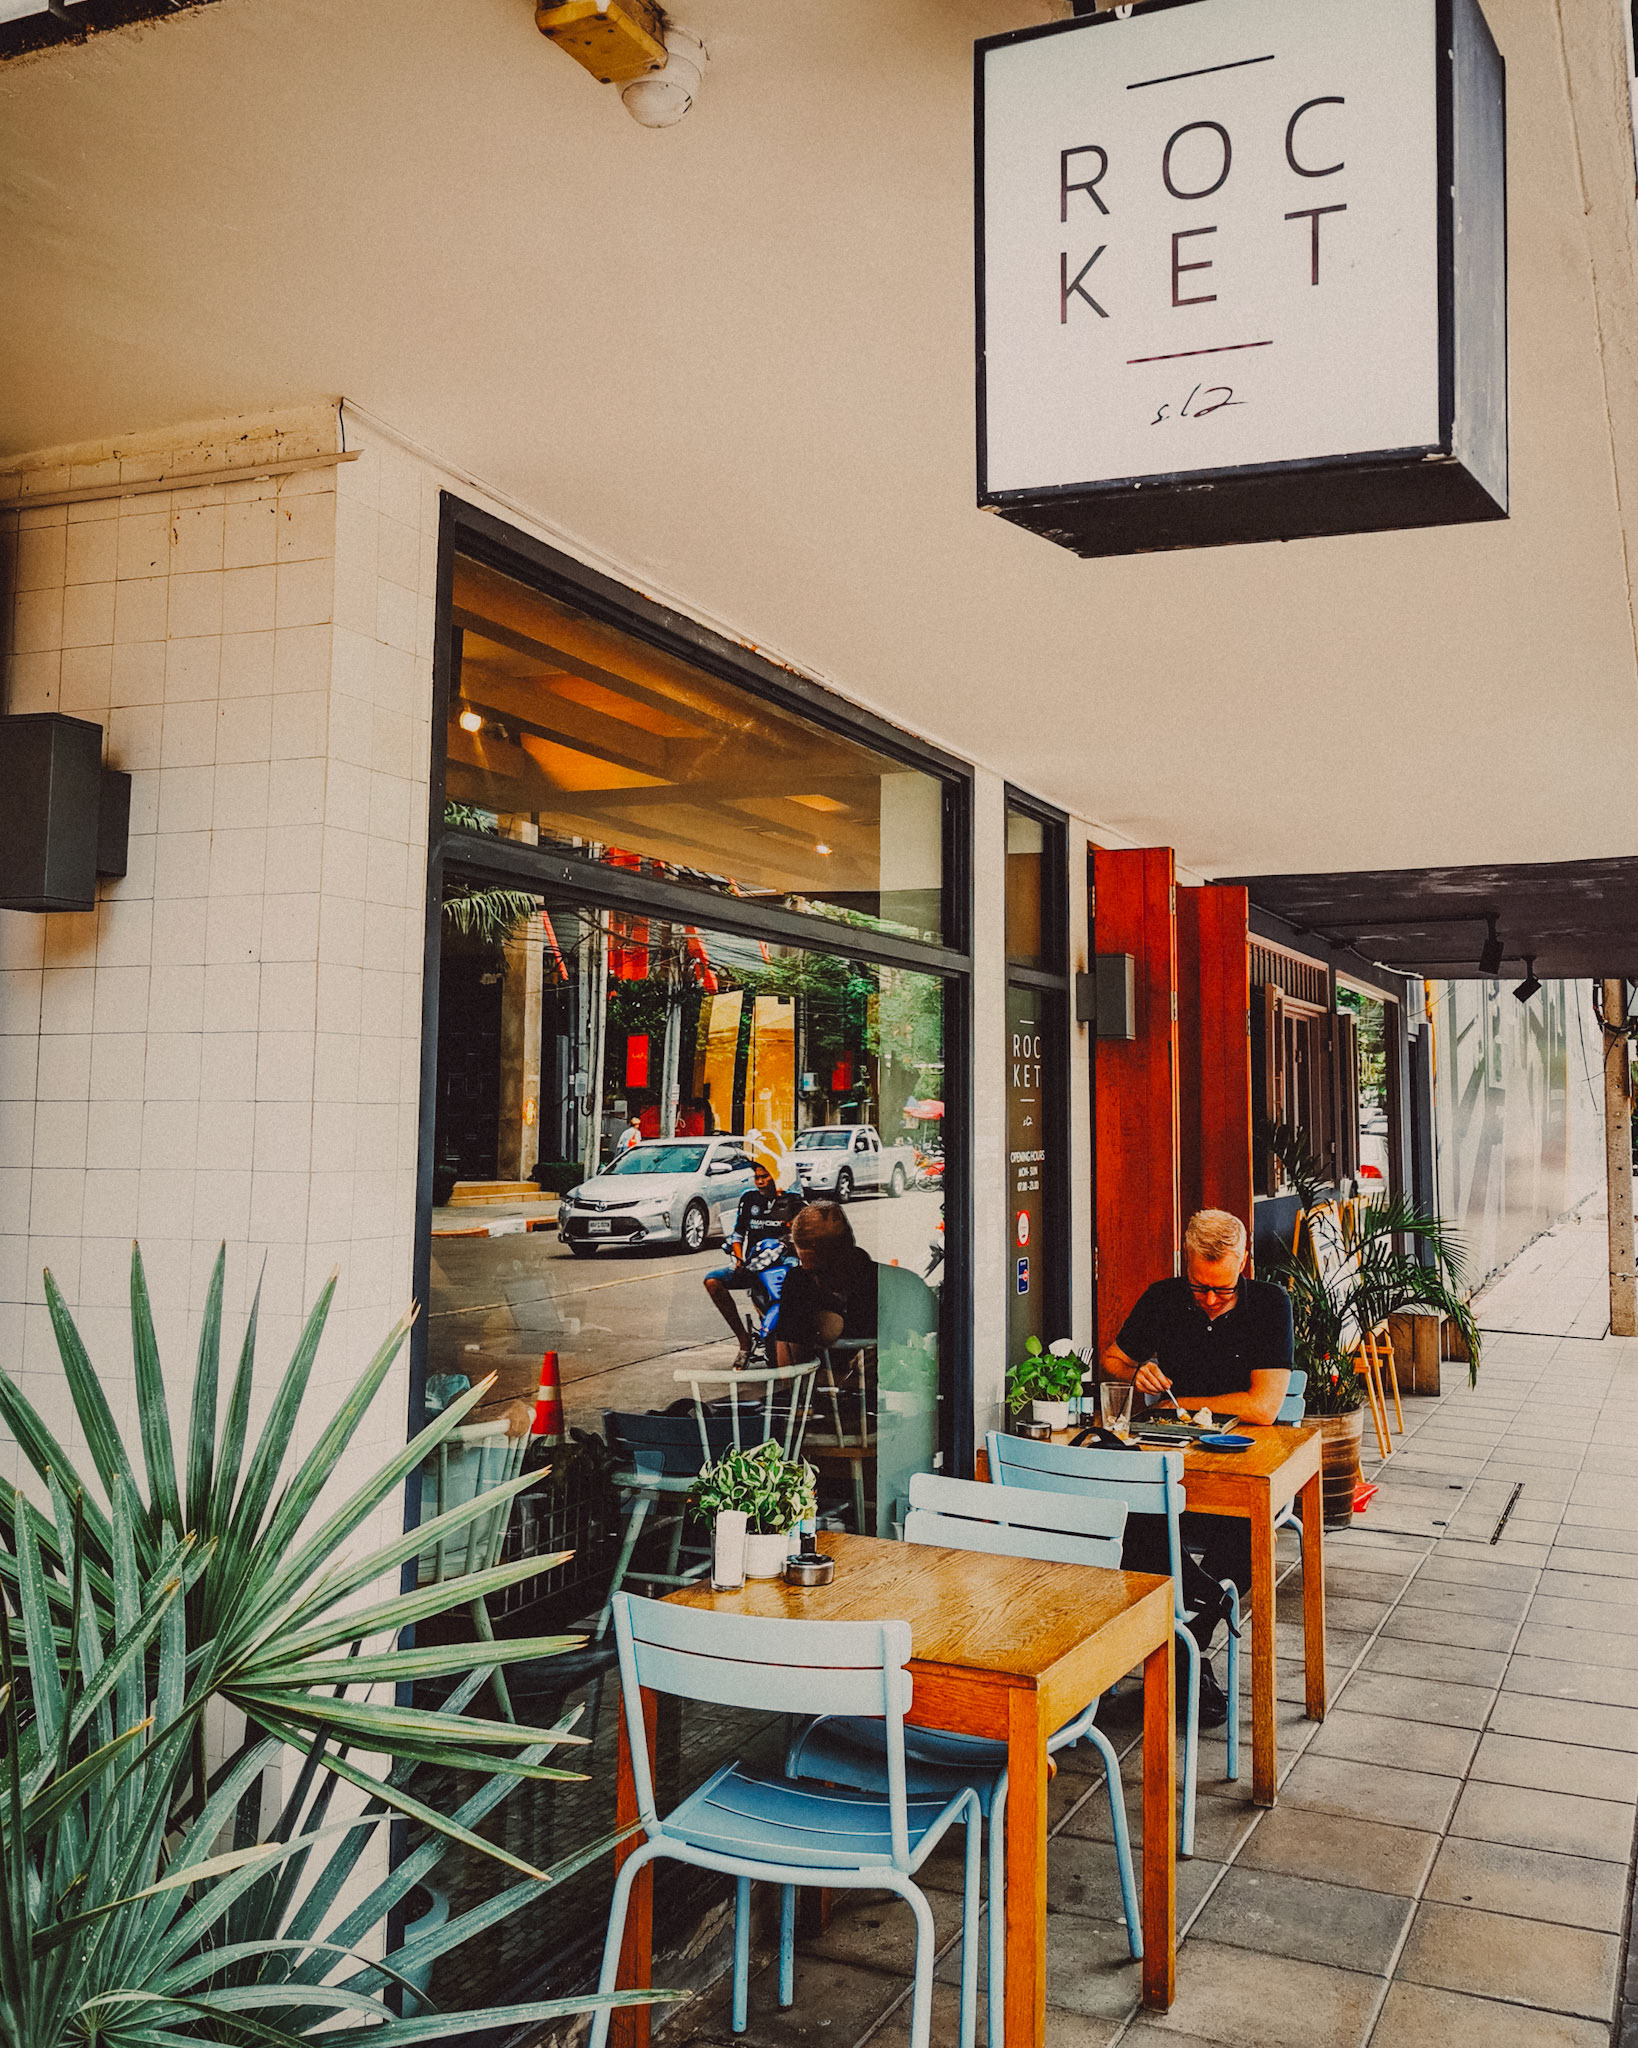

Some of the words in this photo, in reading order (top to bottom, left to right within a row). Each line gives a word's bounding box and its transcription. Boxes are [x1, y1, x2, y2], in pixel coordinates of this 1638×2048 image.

[1060, 96, 1345, 223] ROC
[1060, 203, 1347, 324] KET
[1013, 1034, 1041, 1058] ROC
[1013, 1064, 1041, 1088] KET
